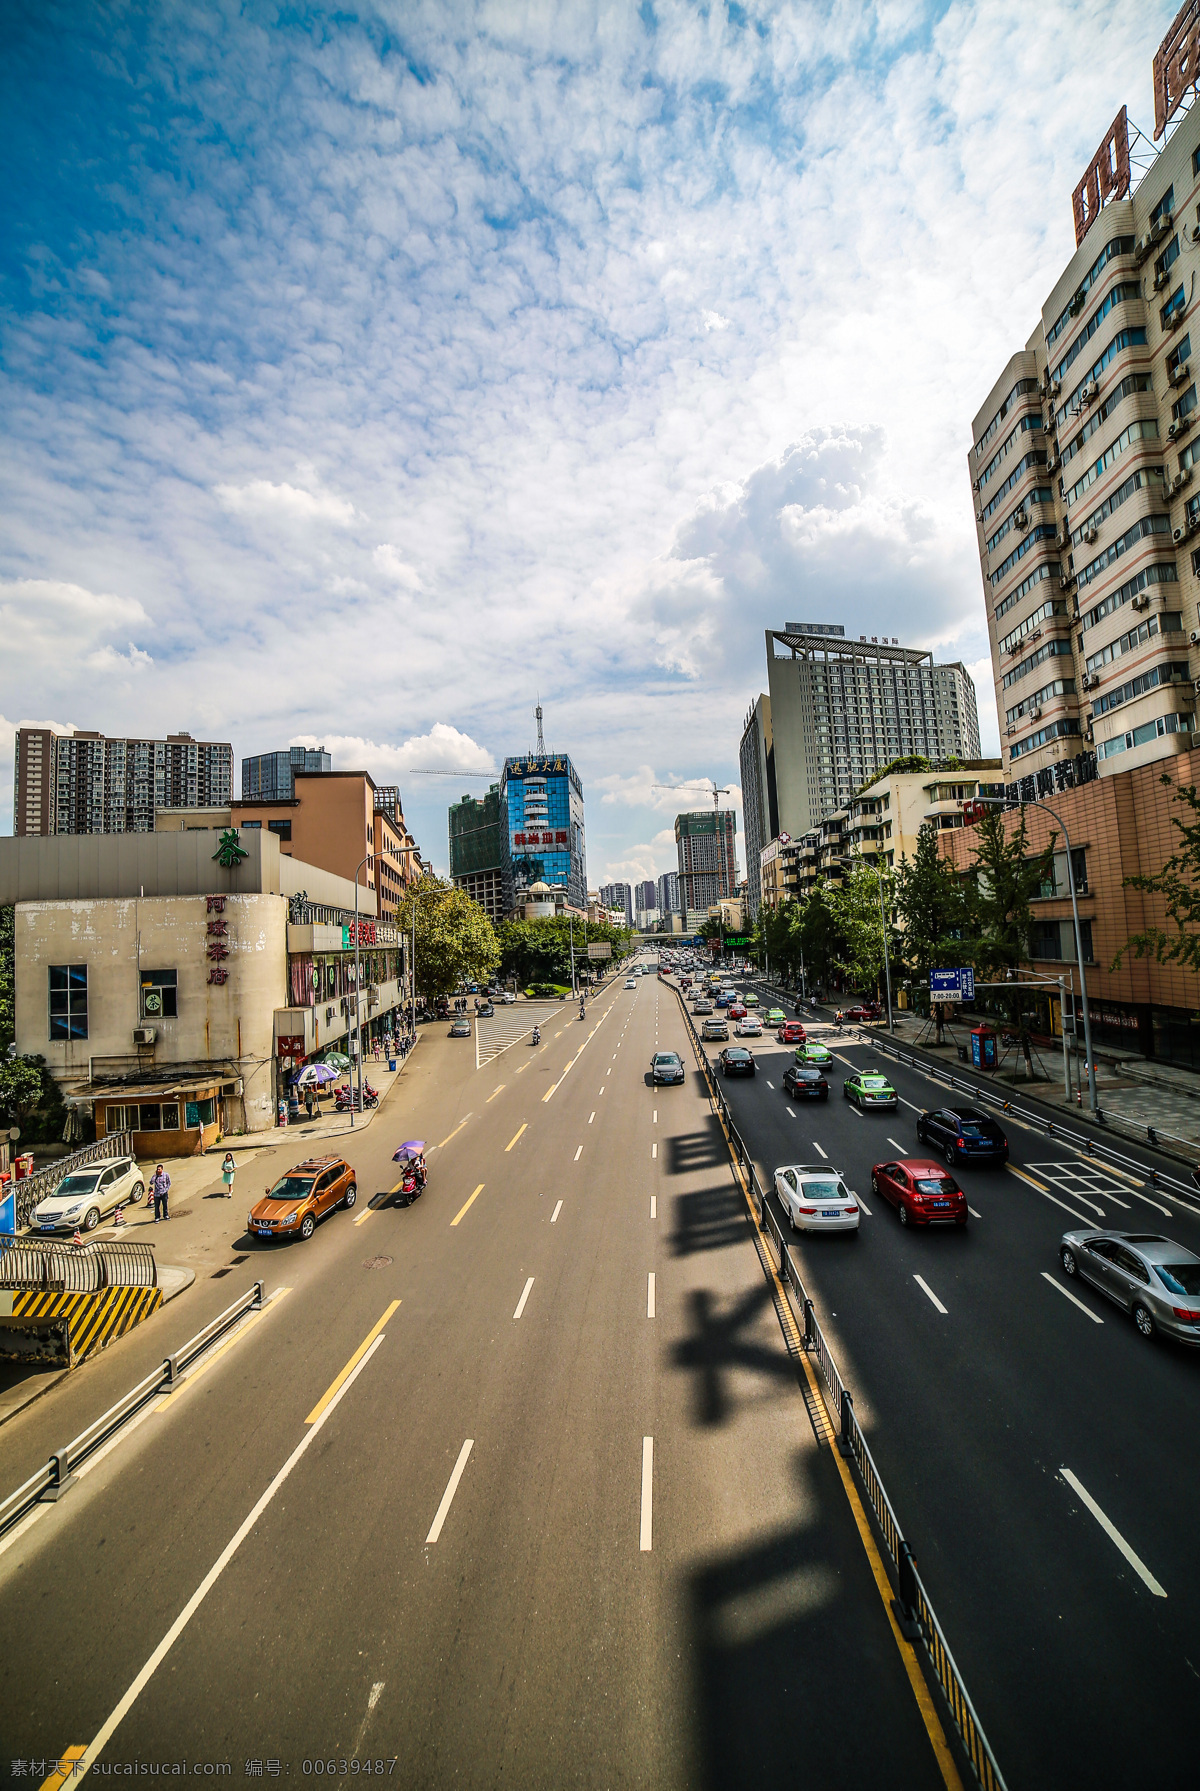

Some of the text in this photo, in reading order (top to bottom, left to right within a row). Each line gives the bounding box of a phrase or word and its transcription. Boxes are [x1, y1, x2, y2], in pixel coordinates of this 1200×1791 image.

[211, 828, 249, 868] 茶
[206, 895, 230, 985] 阿琼茶府
